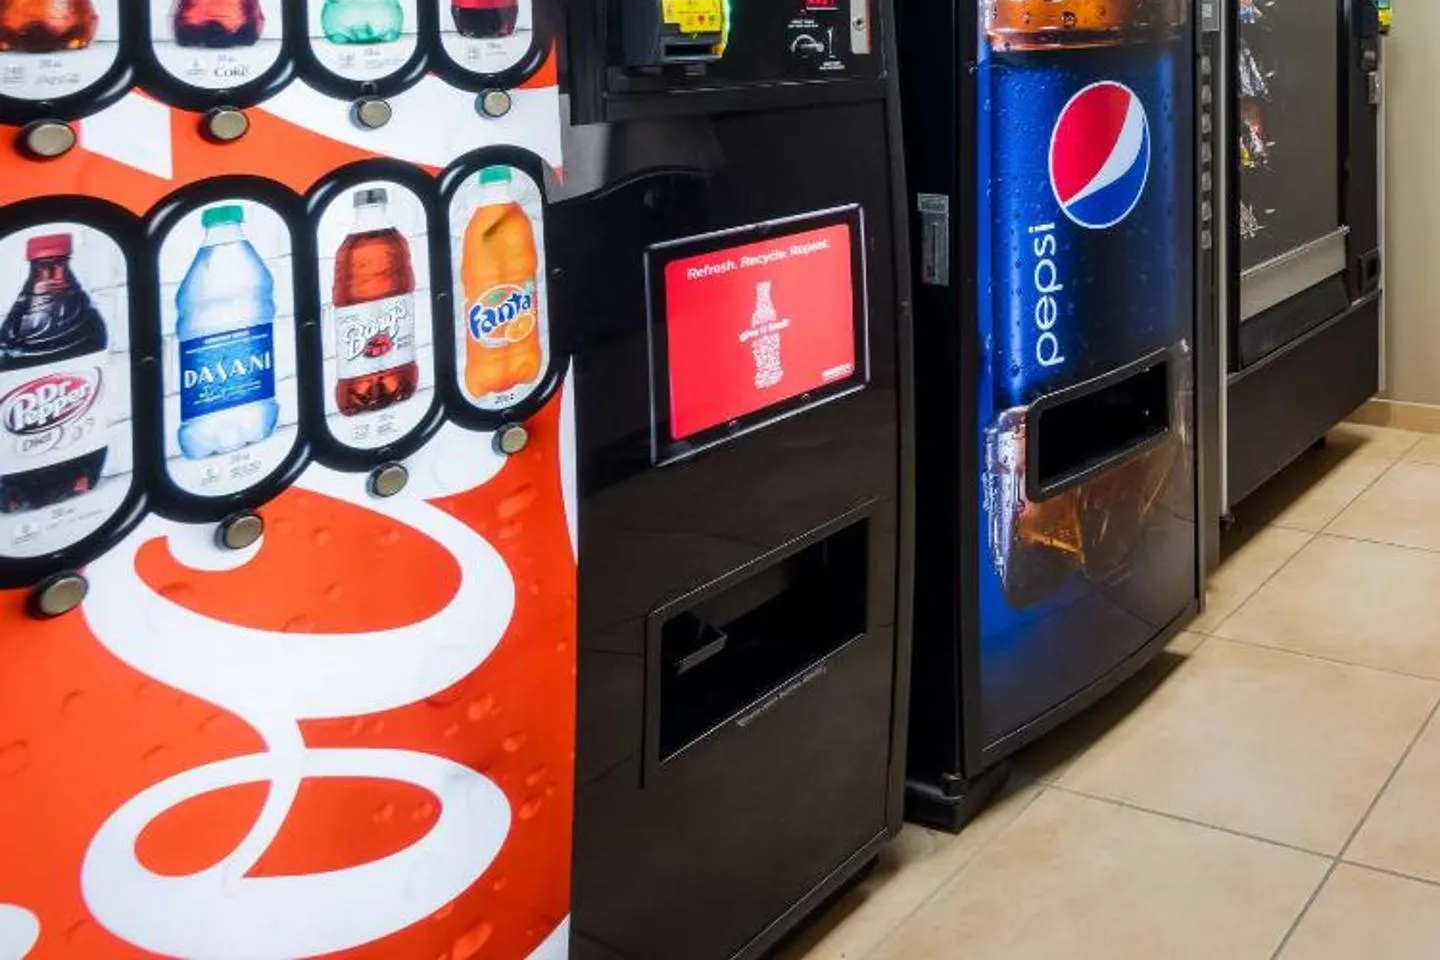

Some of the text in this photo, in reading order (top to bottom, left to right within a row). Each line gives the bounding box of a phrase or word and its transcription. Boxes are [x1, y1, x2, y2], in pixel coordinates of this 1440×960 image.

[687, 259, 738, 280] Refresh.
[468, 291, 533, 340] Fanta
[1029, 222, 1064, 366] pepsi
[183, 352, 271, 389] DASANI
[13, 383, 93, 433] Pepper
[38, 381, 75, 405] Dr
